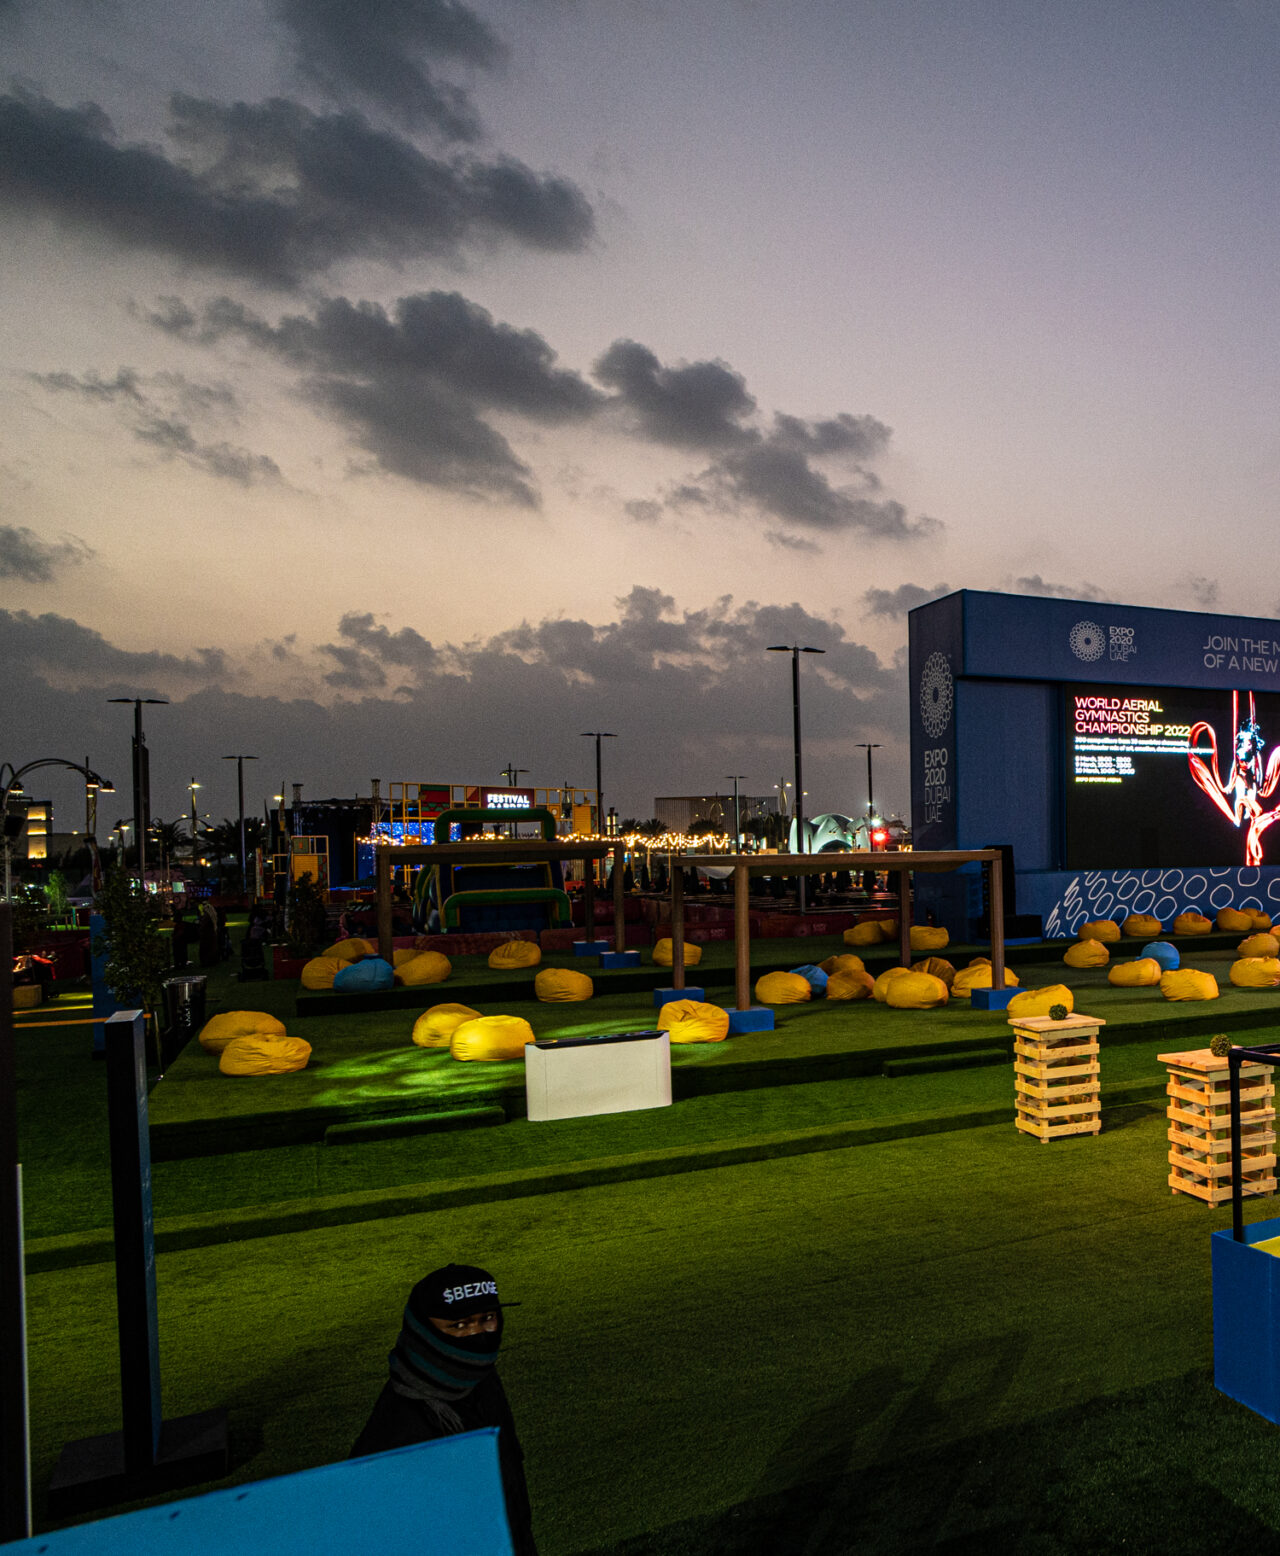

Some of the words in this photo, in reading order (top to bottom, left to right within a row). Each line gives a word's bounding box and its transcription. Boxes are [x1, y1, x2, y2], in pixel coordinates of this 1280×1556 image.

[1109, 626, 1135, 636] EXPO
[1109, 635, 1133, 645] 2020
[1203, 635, 1239, 652] JOIN
[1241, 638, 1270, 655] THE
[1109, 644, 1137, 654] DUBAI
[1109, 653, 1129, 662] UAE
[1204, 653, 1225, 669] OF
[1228, 655, 1241, 671] A
[1243, 656, 1280, 673] NEW
[1074, 696, 1121, 710] WORLD
[1121, 699, 1164, 713] AERIAL
[1074, 709, 1150, 724] GYMNASTICS
[1074, 721, 1164, 736] CHAMPIONSHIP
[1164, 724, 1191, 737] 2022
[924, 748, 948, 768] EXPO
[924, 767, 947, 786] 2020
[487, 793, 530, 804] FESTIVAL
[925, 785, 951, 805] DUBAI
[925, 804, 943, 823] UAE
